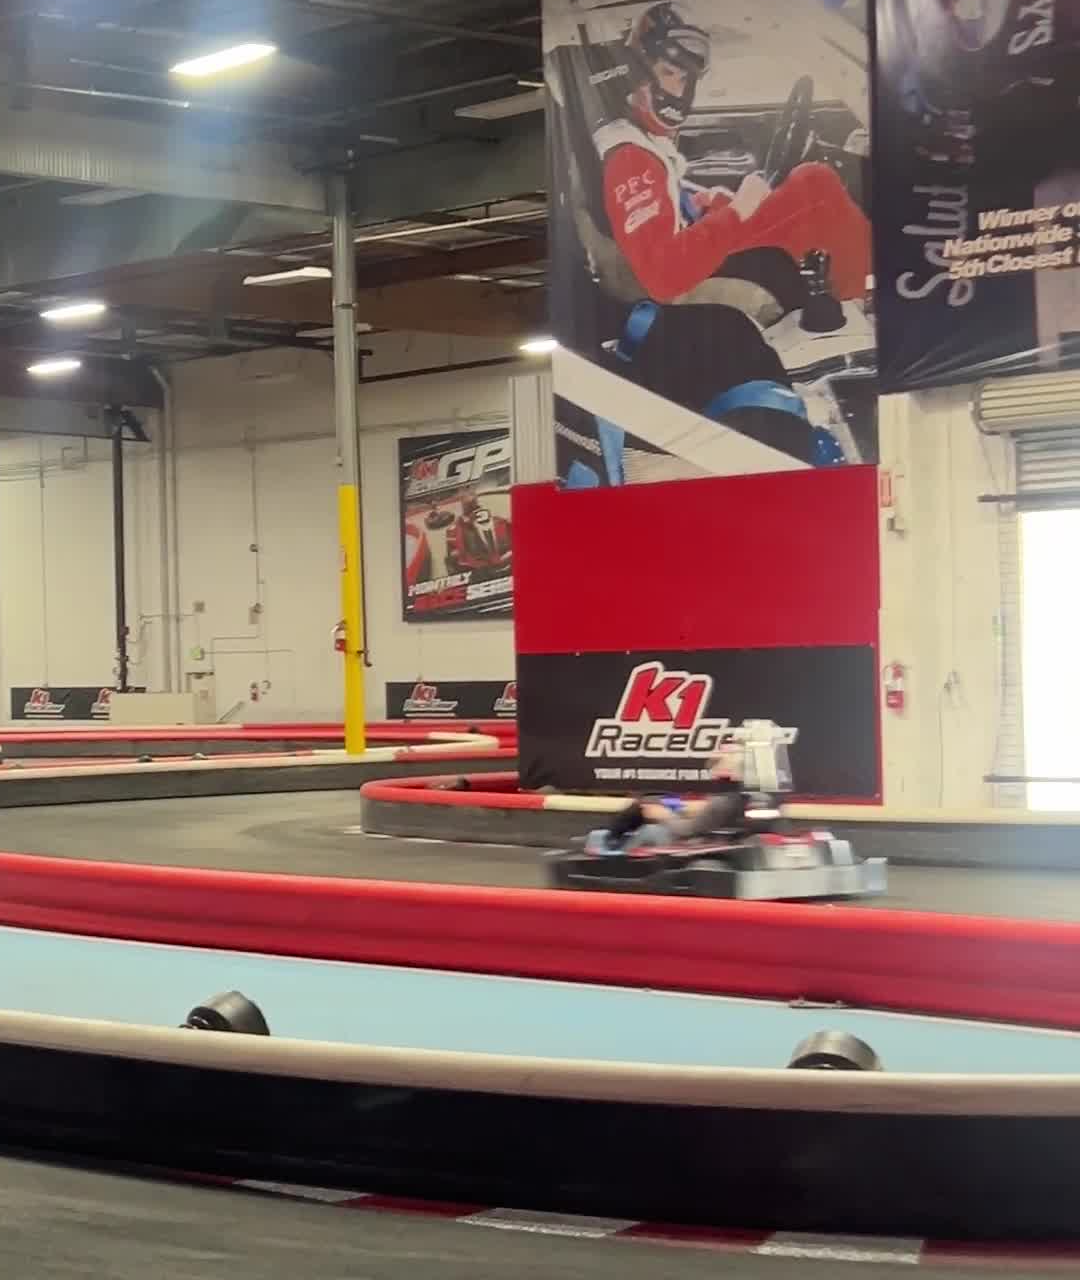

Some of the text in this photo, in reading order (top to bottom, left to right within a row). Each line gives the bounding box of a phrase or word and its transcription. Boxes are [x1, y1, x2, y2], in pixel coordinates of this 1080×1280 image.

[978, 206, 1060, 231] Winner
[942, 224, 1073, 258] Nationwide
[951, 246, 1073, 280] 5th Closest
[617, 663, 709, 731] K1
[591, 722, 738, 753] RaceGe
